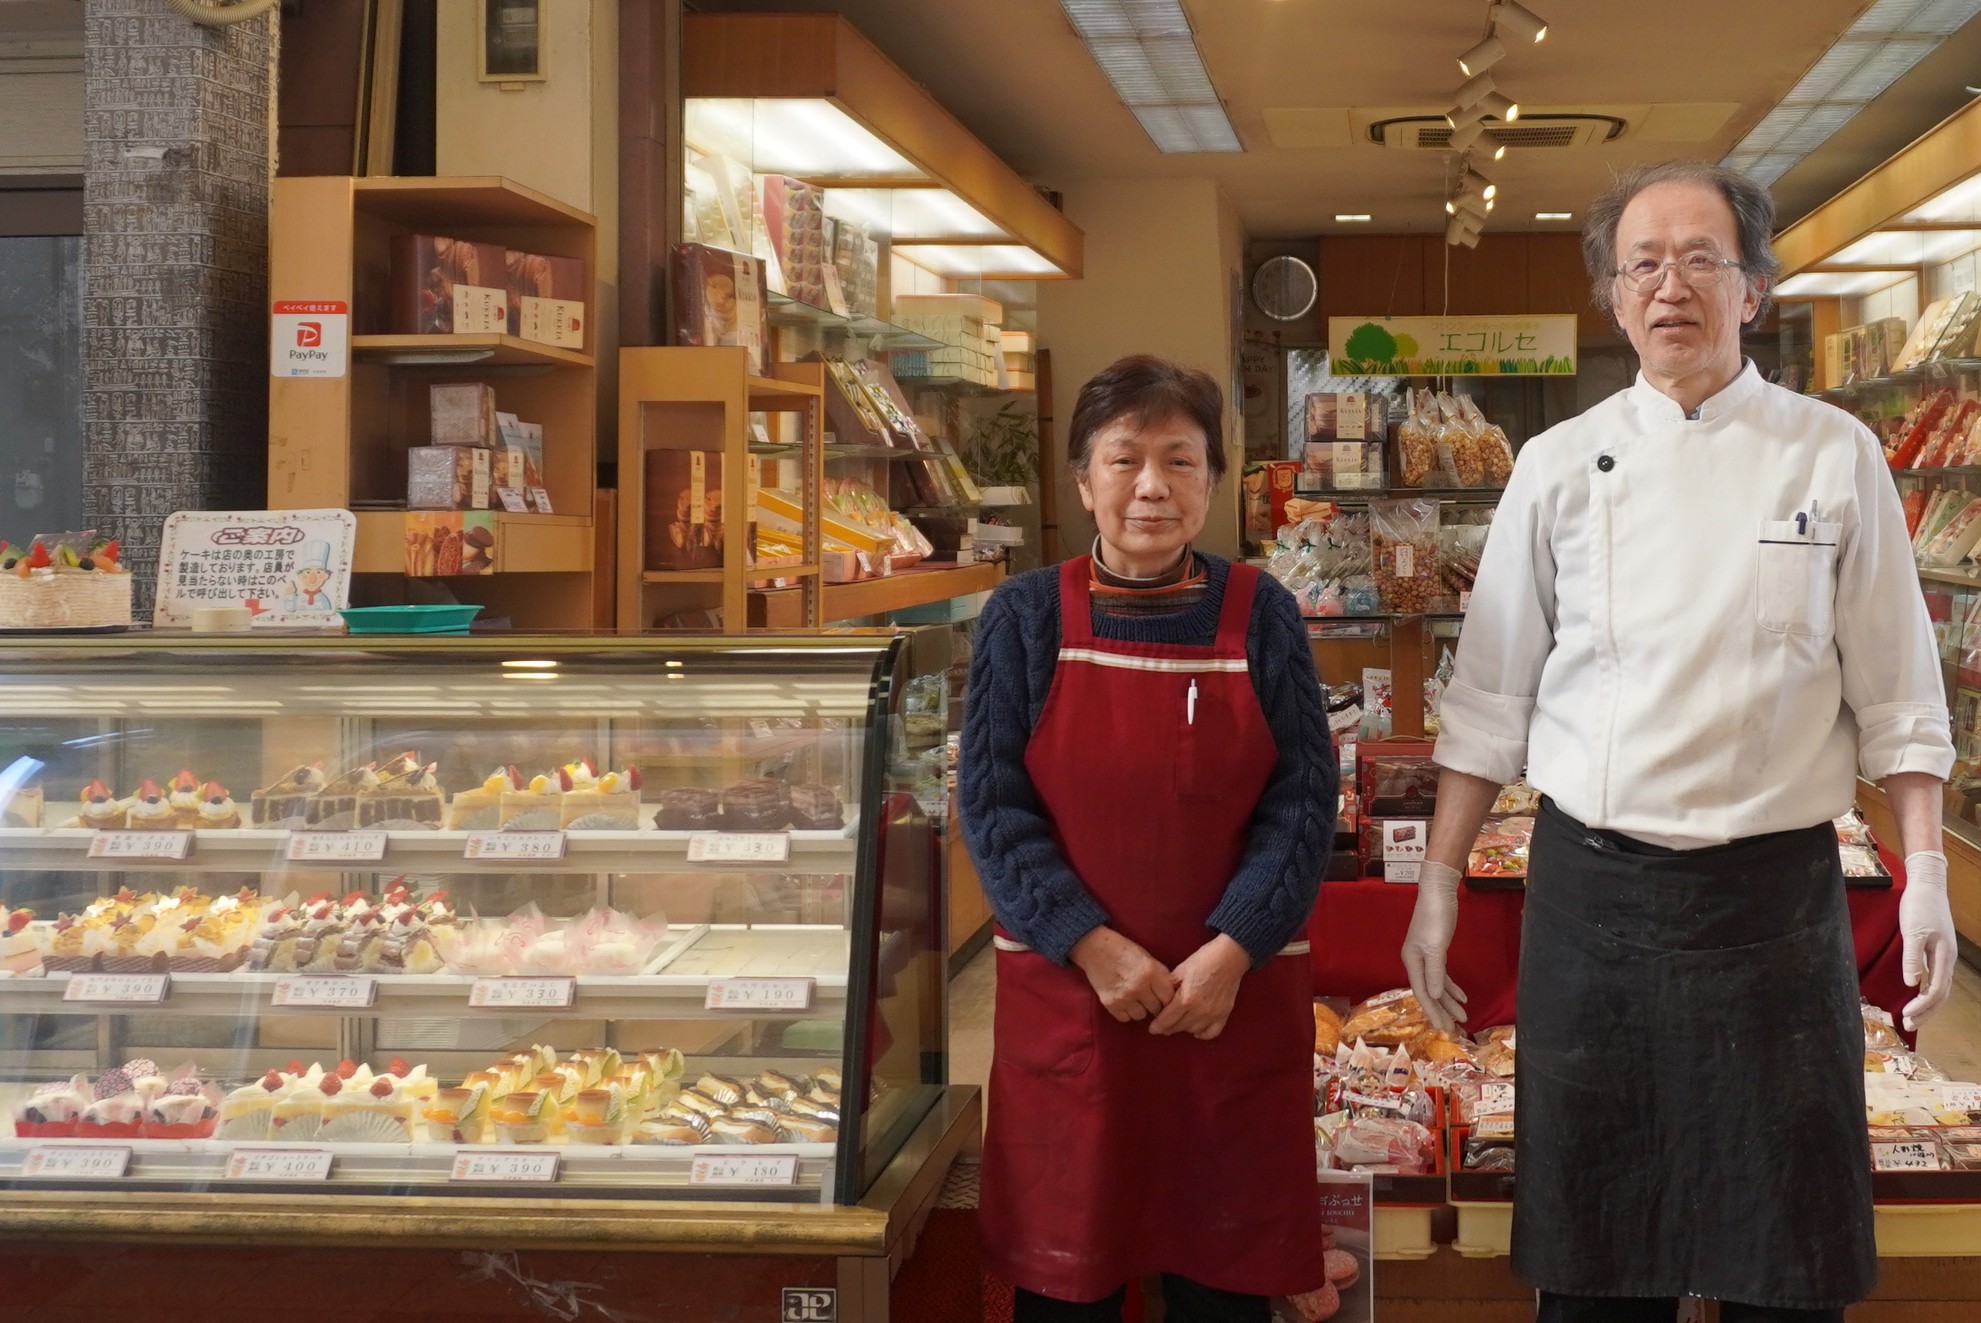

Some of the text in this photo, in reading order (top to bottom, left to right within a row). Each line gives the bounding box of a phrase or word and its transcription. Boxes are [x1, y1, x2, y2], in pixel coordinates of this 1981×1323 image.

[282, 304, 337, 312] ペイペイ使えます
[1440, 331, 1538, 353] エコルセ
[289, 349, 328, 361] PayPay
[215, 526, 296, 545] ご案内
[179, 549, 295, 561] ケーキは店の奥の工房で
[178, 562, 295, 574] 製造しております。店員が
[177, 575, 288, 587] 見当たらない時はこのベ
[176, 587, 281, 600] ルで呼び出して下さい。
[142, 841, 173, 850] 390
[520, 842, 551, 852] 380
[121, 984, 153, 993] 390
[327, 987, 358, 997] 370
[763, 990, 794, 1000] 190
[283, 1161, 316, 1171] 400
[510, 1163, 542, 1173] 390
[753, 1167, 779, 1177] 180
